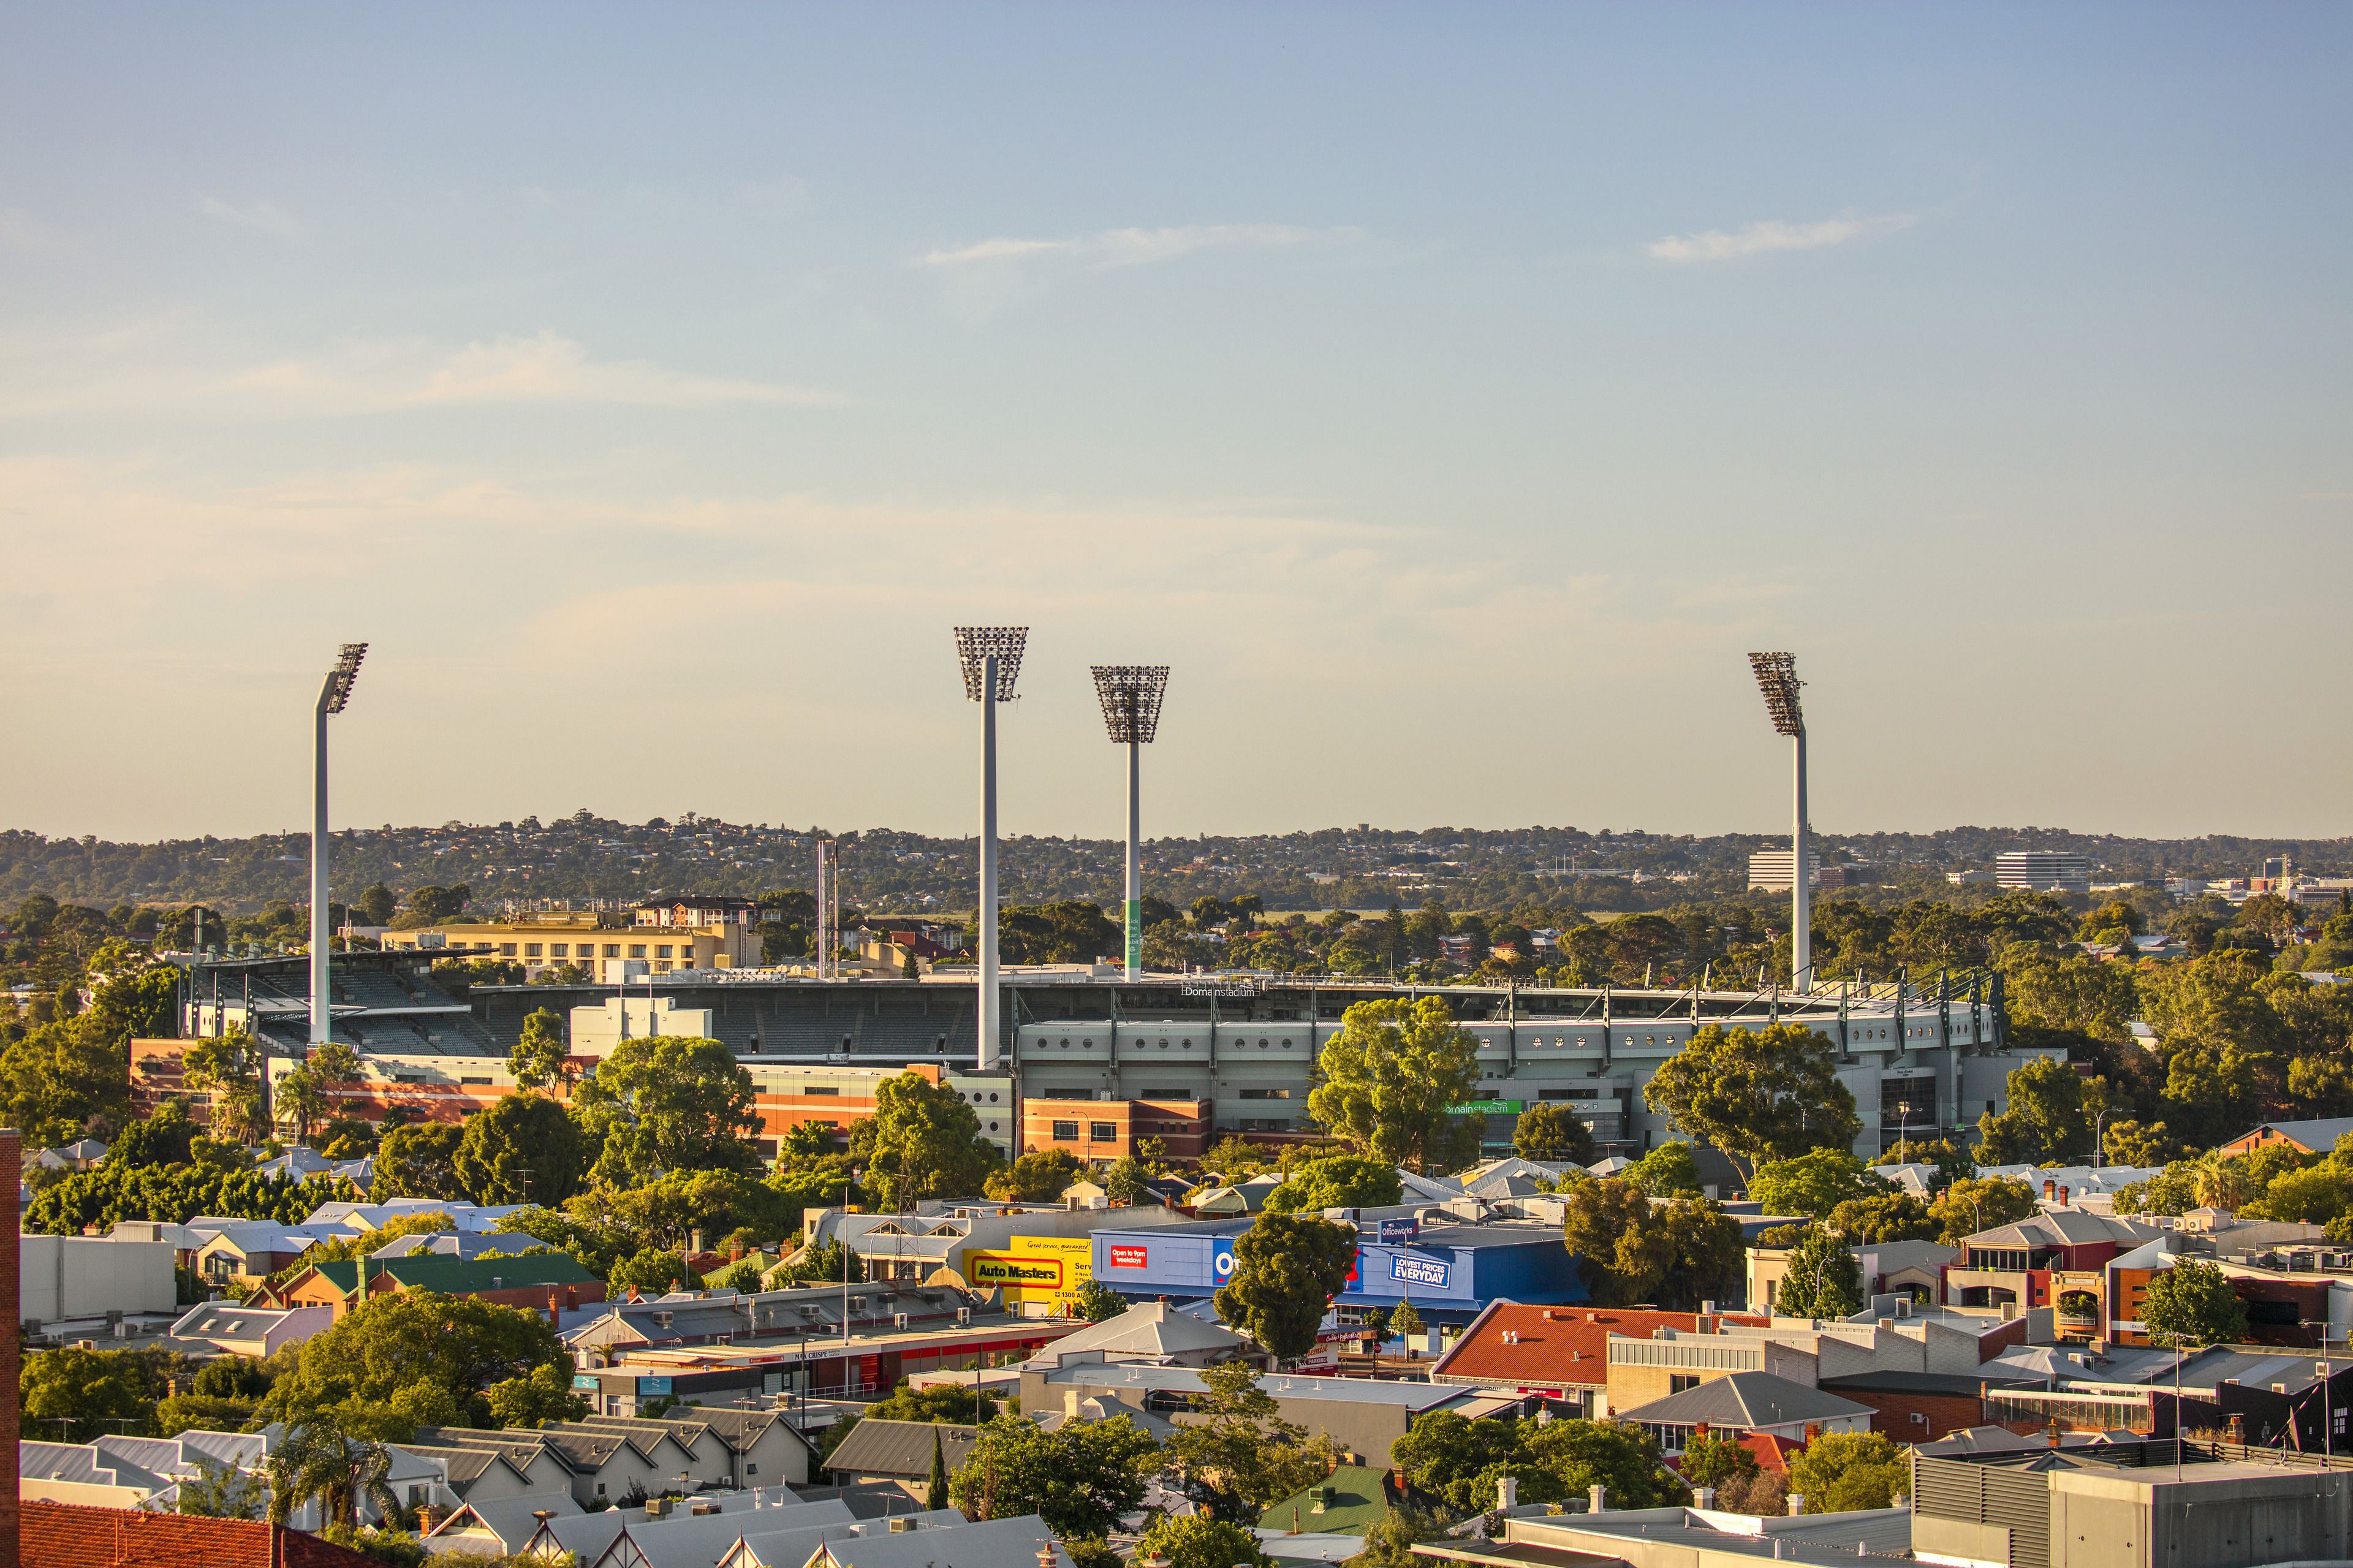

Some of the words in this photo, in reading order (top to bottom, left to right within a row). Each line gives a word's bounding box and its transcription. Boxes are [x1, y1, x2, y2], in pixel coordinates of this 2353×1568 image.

[1382, 1226, 1412, 1236] Officeworks
[1061, 1241, 1091, 1252] guaranteed!
[979, 1265, 1006, 1277] Auto
[1008, 1266, 1057, 1279] Masters
[1396, 1258, 1421, 1270] LOWEST
[1422, 1262, 1445, 1274] PRICES
[1395, 1266, 1445, 1284] EVERYDAY
